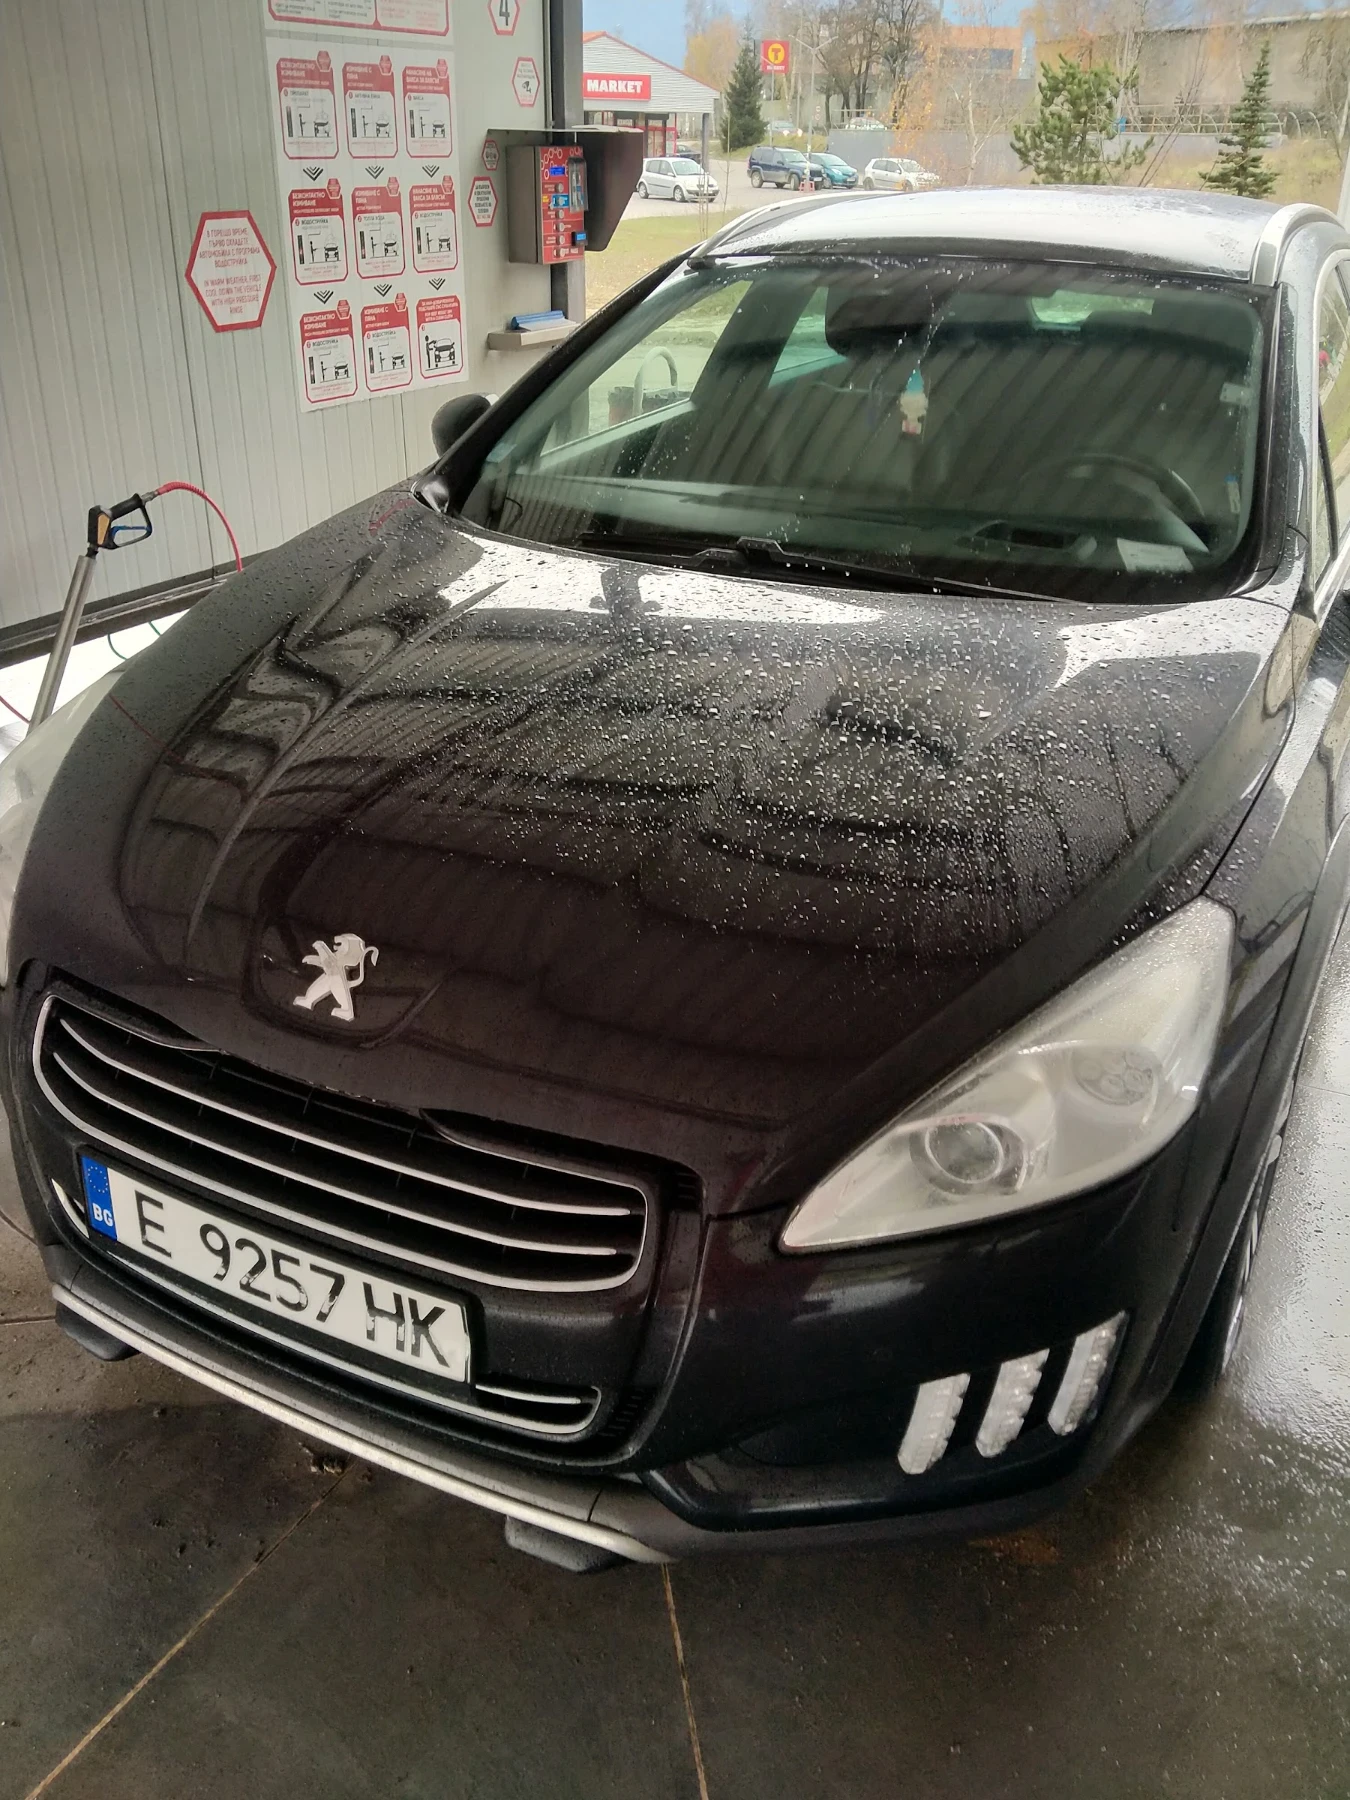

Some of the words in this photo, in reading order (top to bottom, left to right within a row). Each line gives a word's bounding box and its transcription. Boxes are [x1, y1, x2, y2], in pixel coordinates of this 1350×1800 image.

[499, 0, 510, 26] 4
[772, 48, 781, 60] T
[587, 79, 642, 93] MARKET
[200, 249, 231, 258] АВТОМОБИЛА
[215, 259, 248, 268] ВОДОСТРУЙКА
[211, 279, 225, 287] WARM
[249, 275, 261, 283] FIRST
[206, 289, 218, 297] COOL
[219, 288, 234, 296] DOWN
[235, 287, 244, 295] THE
[244, 284, 262, 293] VEHICLE
[212, 299, 224, 307] WITH
[230, 306, 243, 314] RINSE
[93, 1203, 113, 1227] BG
[135, 1191, 171, 1258] E
[200, 1223, 345, 1322] 9257
[363, 1282, 449, 1367] HK
